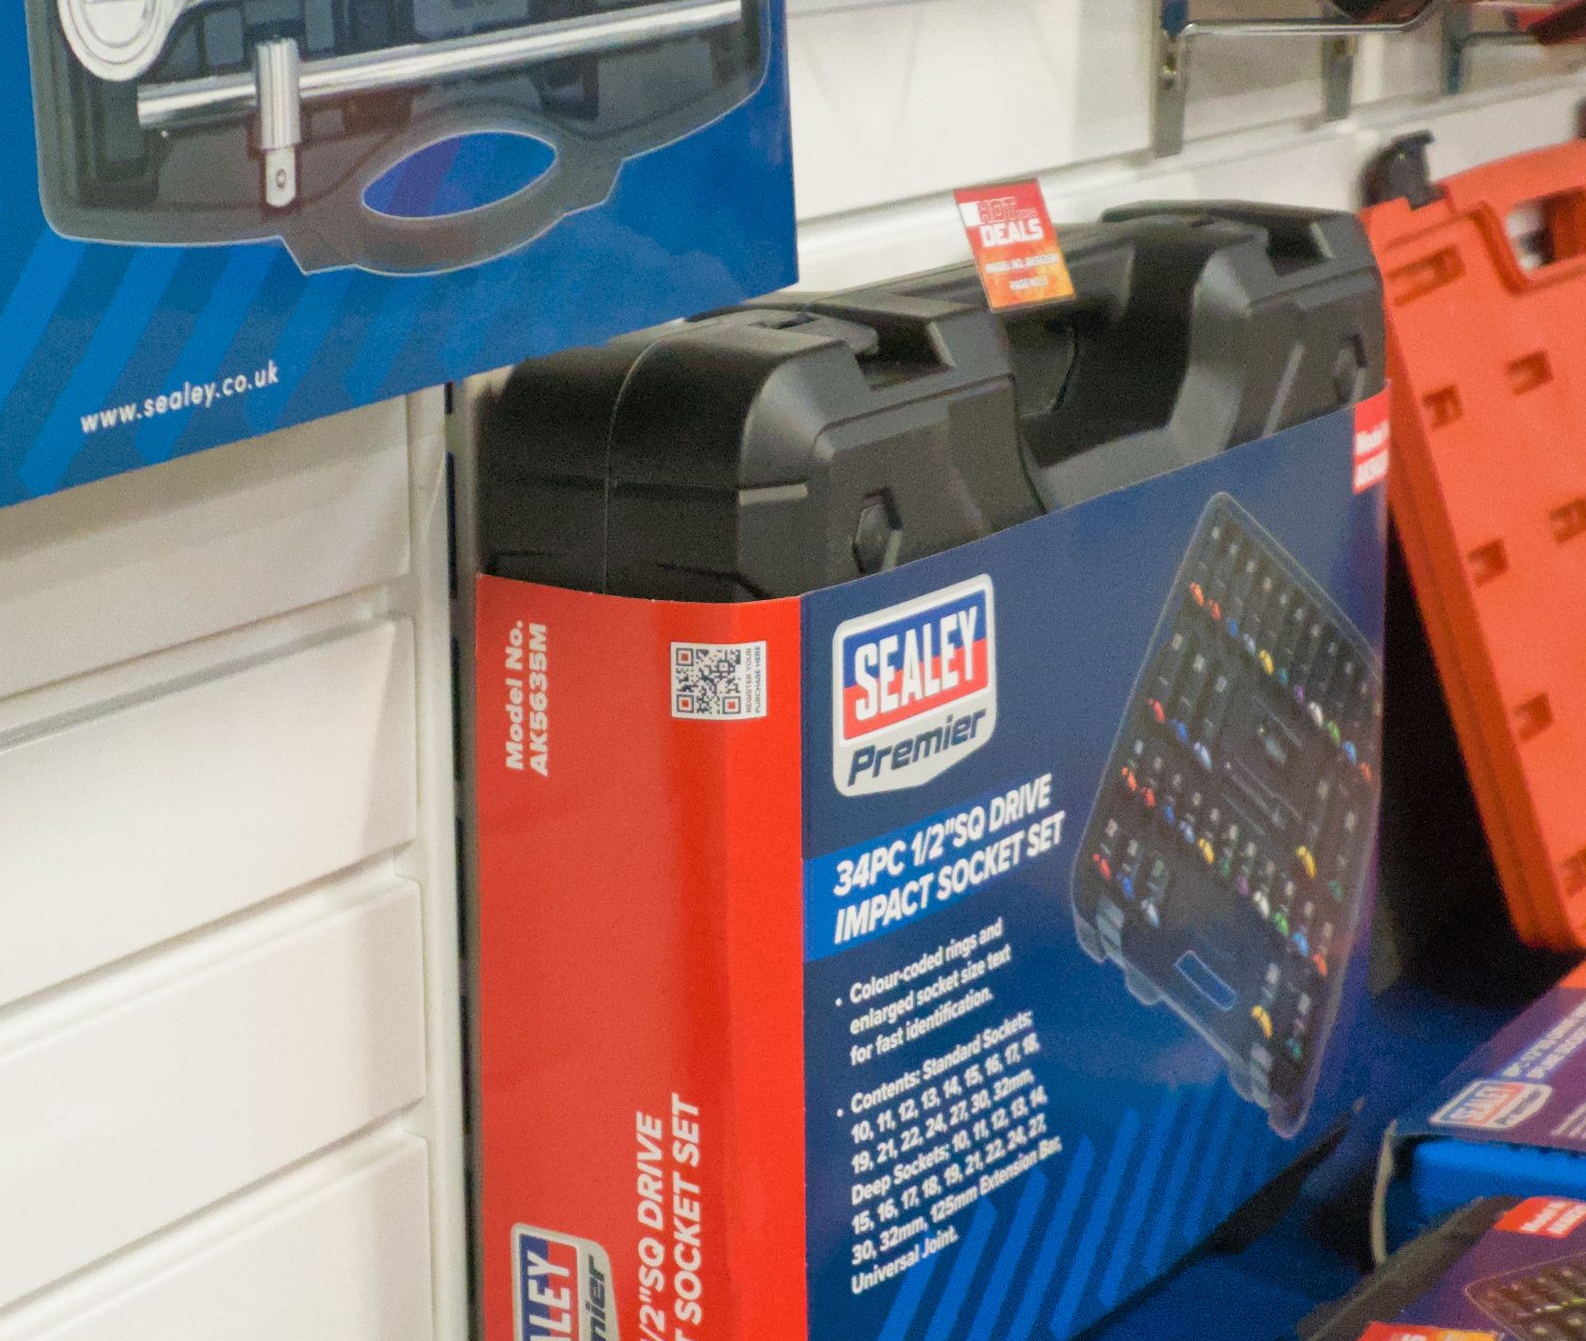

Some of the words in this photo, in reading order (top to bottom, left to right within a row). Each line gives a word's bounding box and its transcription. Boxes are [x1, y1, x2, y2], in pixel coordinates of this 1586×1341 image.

[979, 218, 1044, 248] DEALS
[80, 360, 279, 433] www.sealey.co.uk
[505, 620, 523, 669] No.
[855, 605, 976, 721] SEALEY
[505, 675, 523, 771] Model
[529, 623, 548, 776] AK5635M
[847, 708, 986, 787] Premier
[834, 846, 903, 895] 34PC
[910, 812, 984, 868] 1/2"SQ
[989, 773, 1052, 833] DRIVE
[834, 877, 931, 944] IMPACT
[937, 832, 1025, 899] SOCKET
[1027, 811, 1066, 859] SET
[850, 946, 944, 1004] Colour-coded
[946, 934, 977, 963] rings
[979, 917, 1003, 943] and
[850, 997, 913, 1035] enlarged
[916, 974, 958, 1006] socket
[961, 959, 985, 987] size
[986, 944, 1011, 971] text
[850, 1045, 873, 1066] for
[875, 1032, 903, 1055] fast
[906, 986, 994, 1041] identification.
[637, 1111, 663, 1230] DRIVE
[671, 1092, 700, 1168] SET
[673, 1171, 702, 1325] SOCKET
